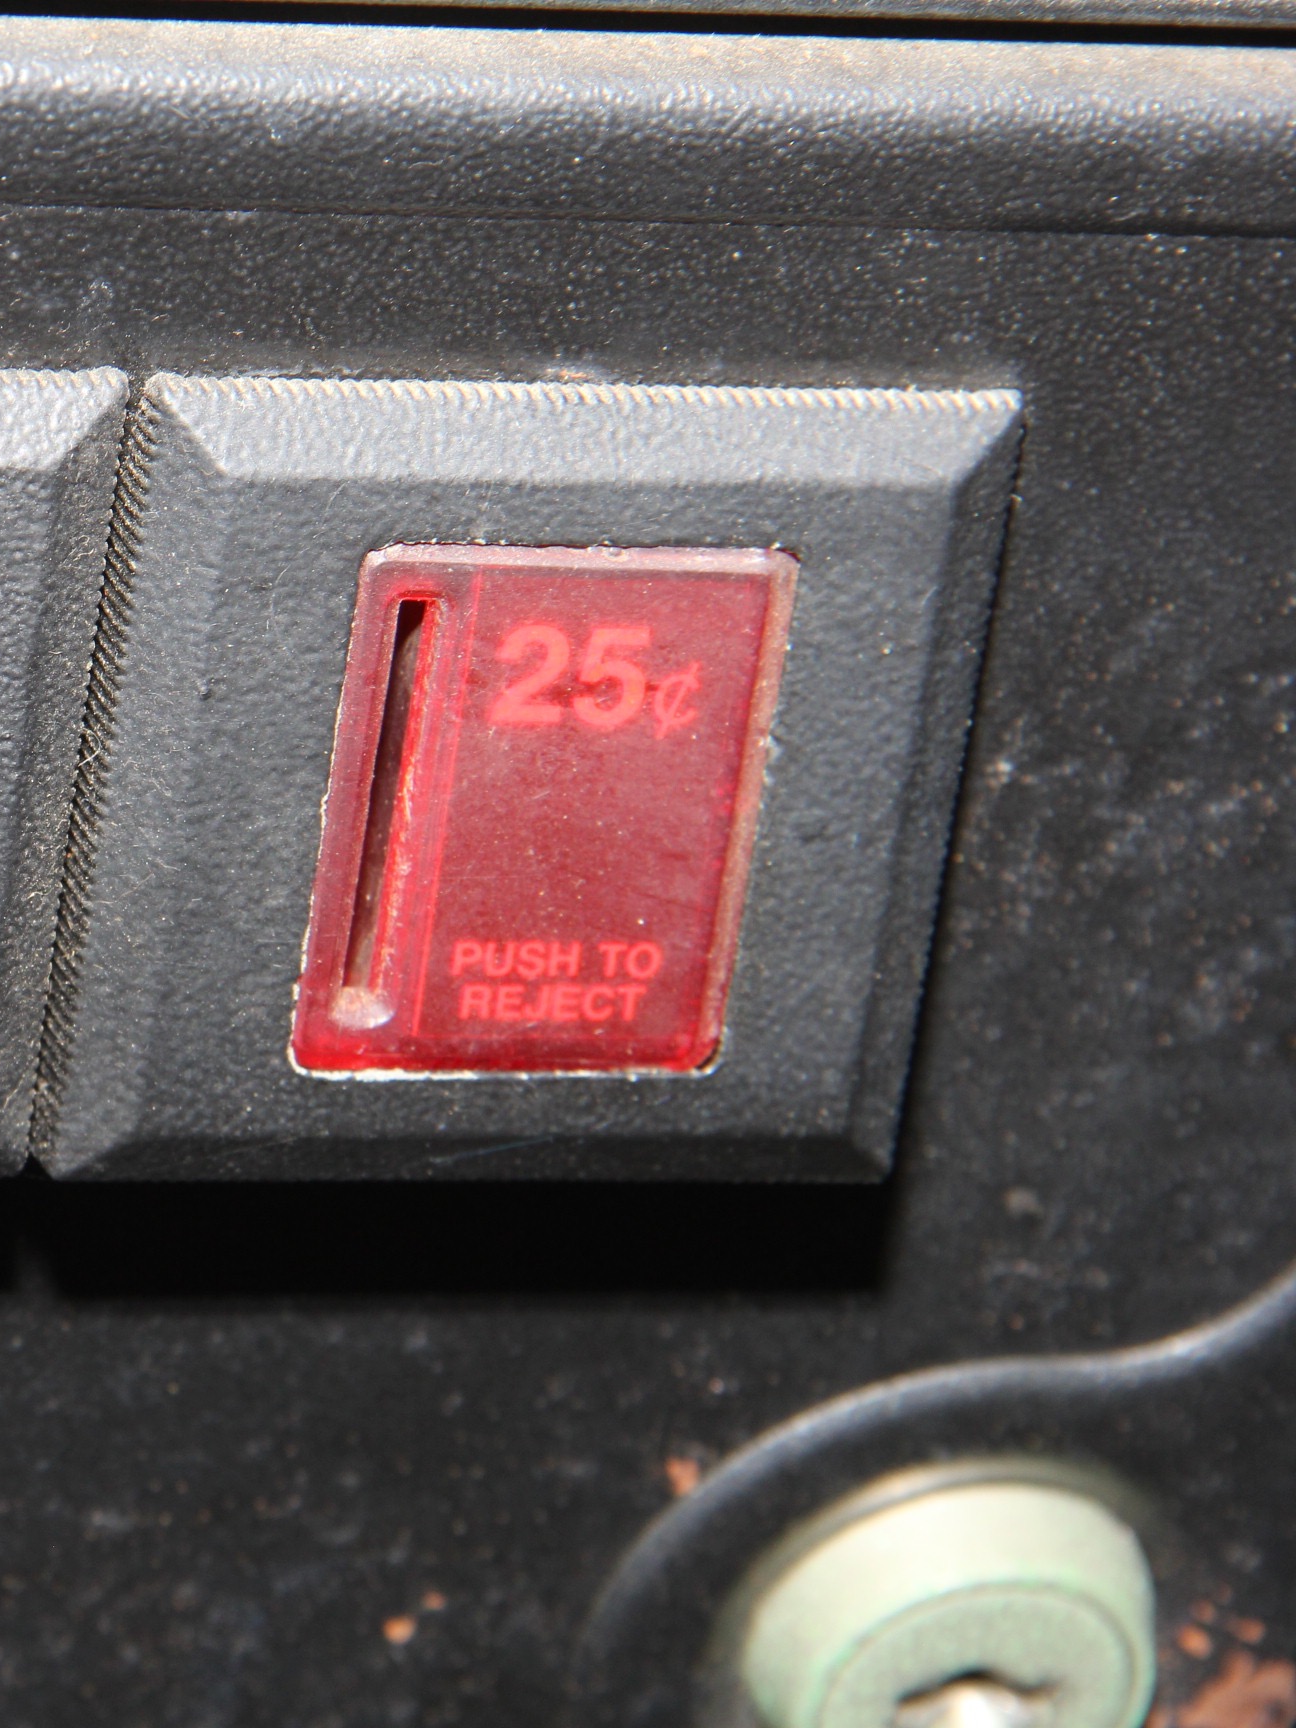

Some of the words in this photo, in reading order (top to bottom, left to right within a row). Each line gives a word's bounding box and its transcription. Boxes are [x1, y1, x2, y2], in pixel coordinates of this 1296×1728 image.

[487, 624, 702, 740] 25¢
[451, 941, 582, 977] PUSH
[599, 941, 664, 979] TO
[459, 984, 646, 1021] REJECT
